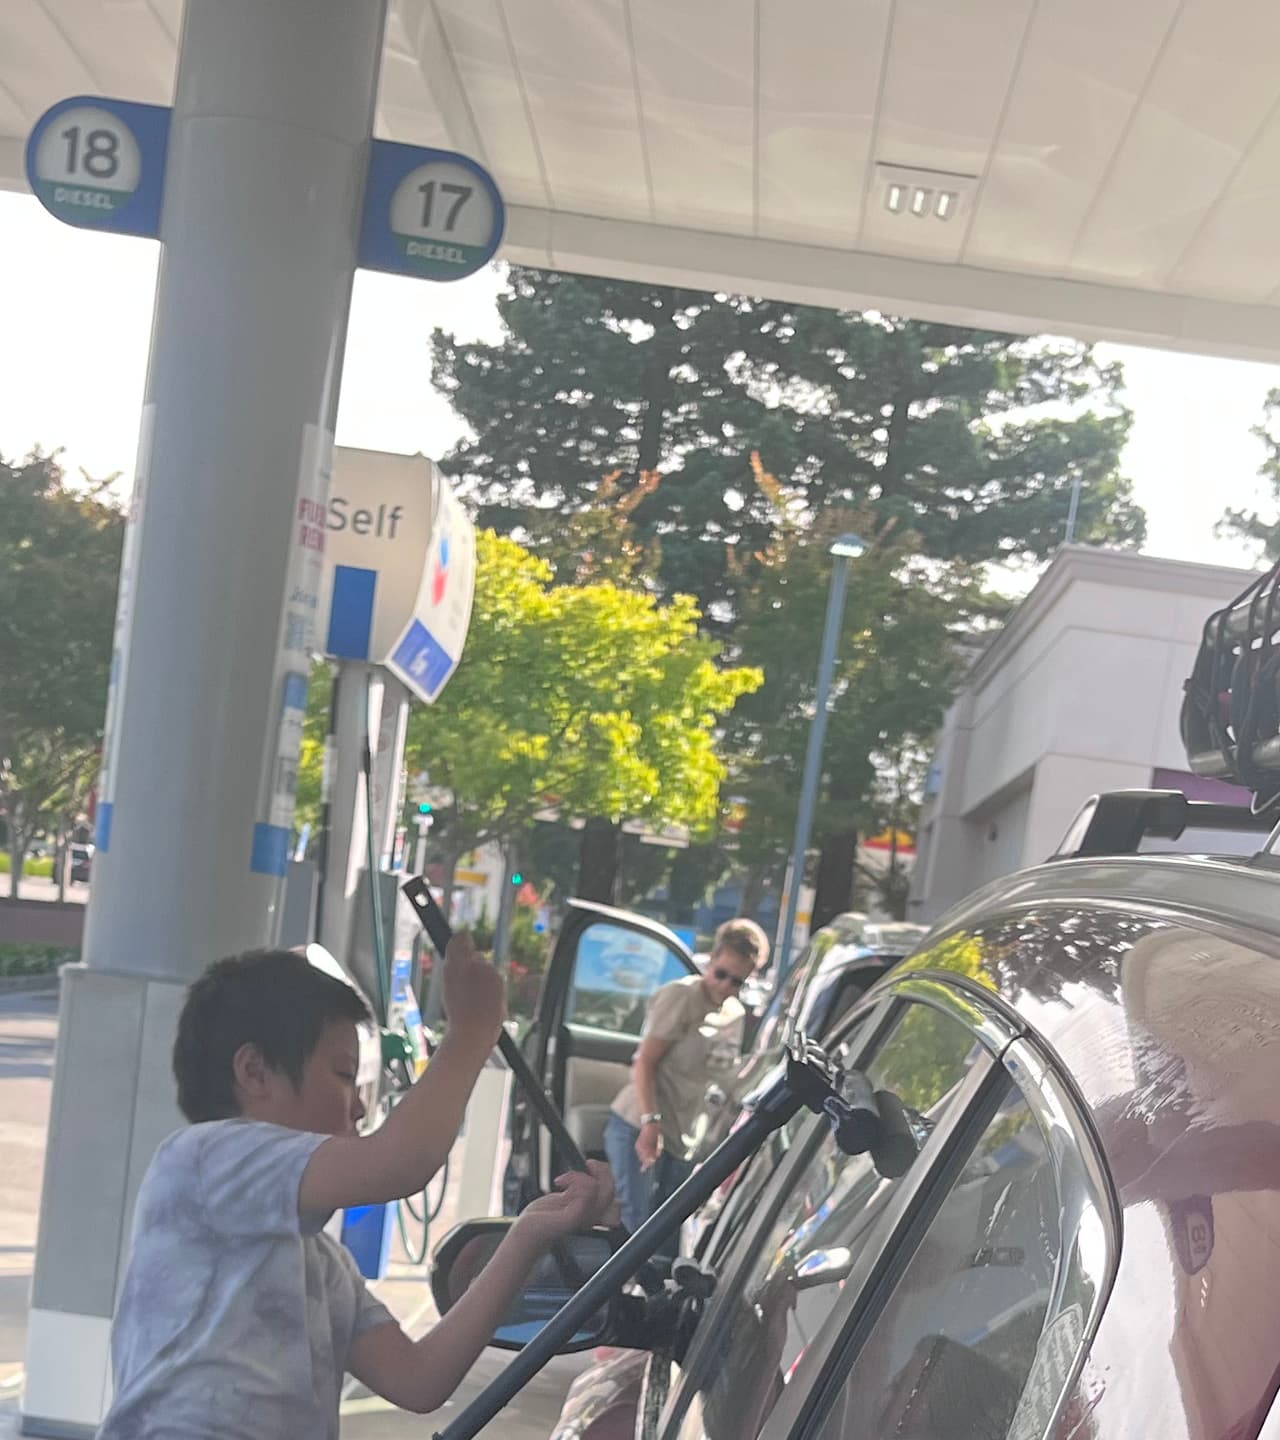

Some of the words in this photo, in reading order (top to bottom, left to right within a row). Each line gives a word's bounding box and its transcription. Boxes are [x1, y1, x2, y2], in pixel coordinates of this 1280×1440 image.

[60, 125, 120, 180] 18
[53, 185, 115, 210] DIESEL
[416, 180, 474, 233] 17
[406, 240, 468, 265] DIESEL
[326, 497, 404, 540] Self
